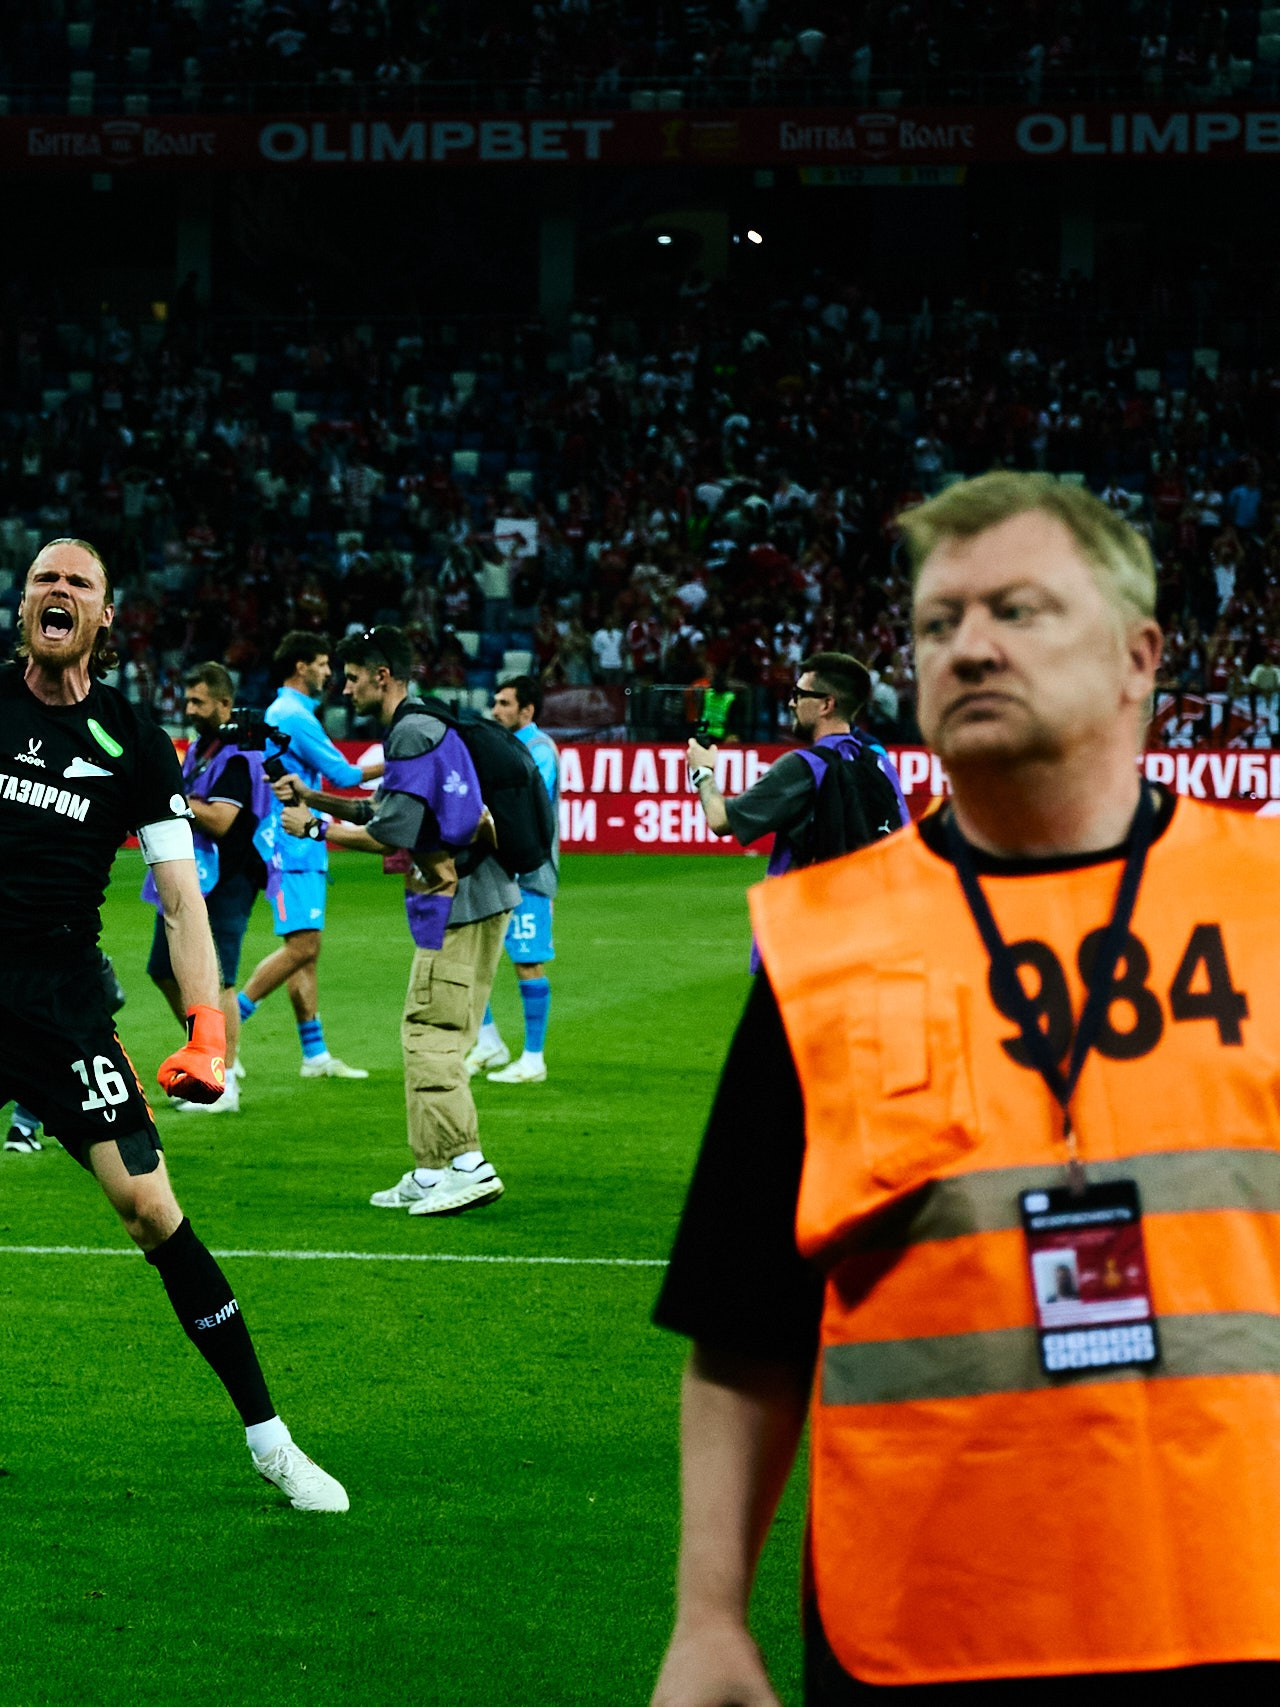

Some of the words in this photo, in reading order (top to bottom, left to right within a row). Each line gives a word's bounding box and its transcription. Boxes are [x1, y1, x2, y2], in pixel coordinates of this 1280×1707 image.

[257, 120, 615, 162] OLIMPBET
[511, 912, 537, 940] 15
[988, 922, 1250, 1070] 984
[71, 1054, 130, 1111] 16
[194, 1298, 240, 1330] ЗЕНИТ
